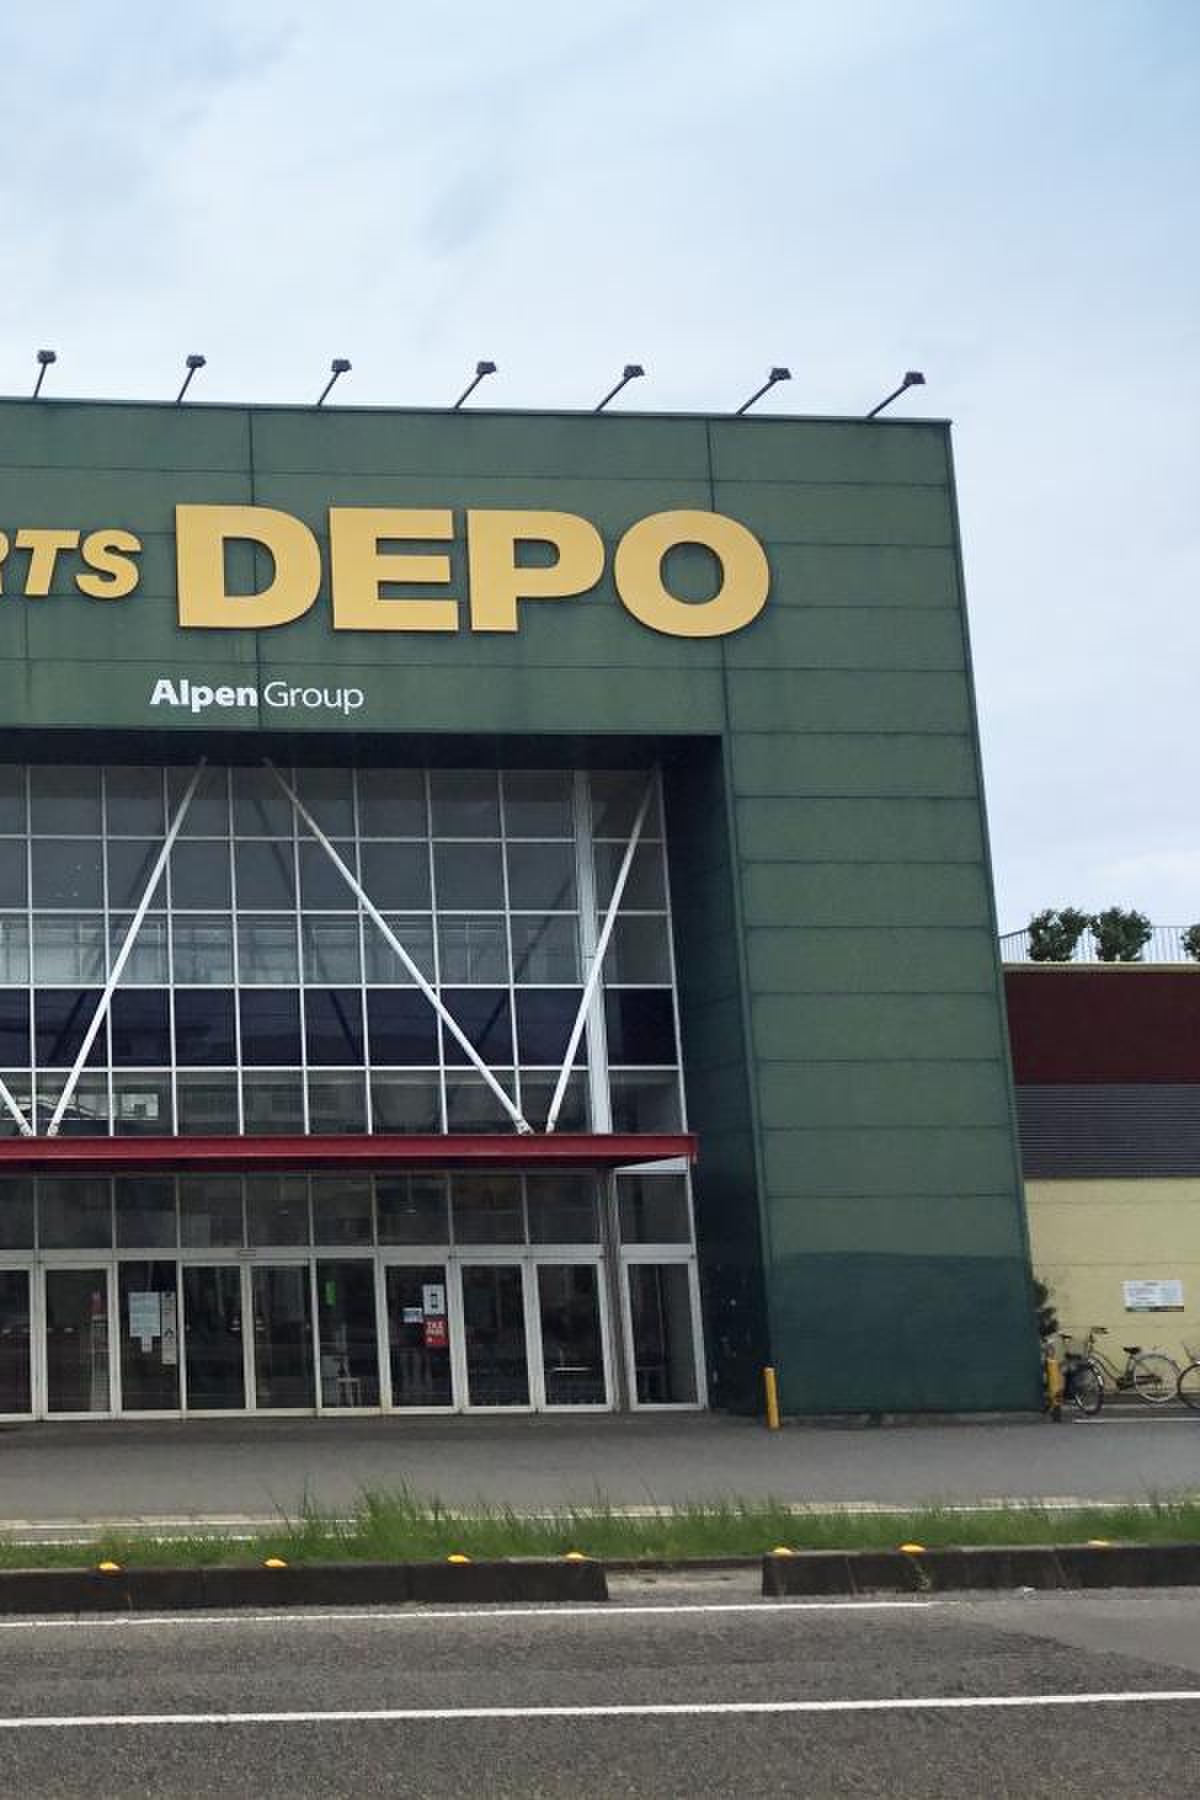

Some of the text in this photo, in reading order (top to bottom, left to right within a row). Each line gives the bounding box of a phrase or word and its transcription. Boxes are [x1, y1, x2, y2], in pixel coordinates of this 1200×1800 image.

[175, 503, 770, 637] DEPO
[149, 678, 366, 716] Alpen Group
